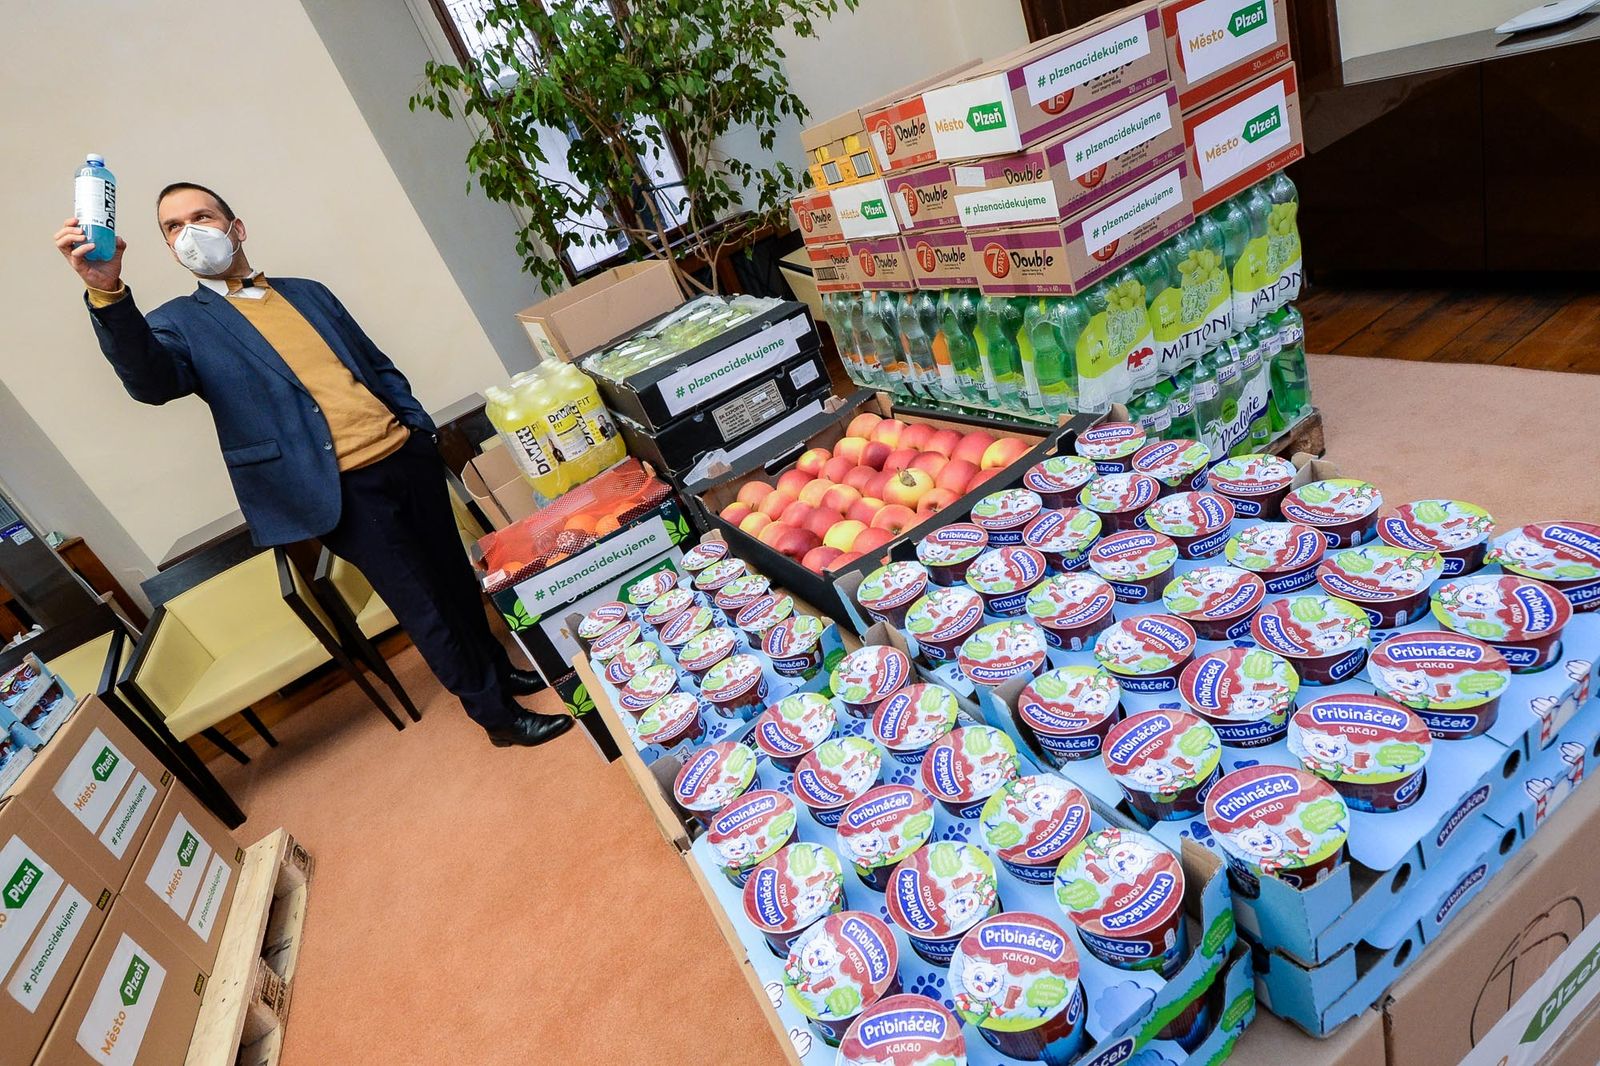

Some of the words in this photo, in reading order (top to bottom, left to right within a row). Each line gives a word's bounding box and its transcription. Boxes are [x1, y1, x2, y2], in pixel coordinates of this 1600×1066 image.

[1189, 29, 1224, 53] Město
[1235, 6, 1264, 31] Plzeň
[1048, 35, 1139, 84] plzenacidekujeme
[894, 118, 926, 141] Double
[935, 119, 964, 134] Město
[973, 108, 1002, 126] Plzeň
[1085, 112, 1161, 160] plzenacidekujeme
[1205, 138, 1239, 162] Město
[1249, 112, 1278, 138] Plzeň
[1004, 162, 1043, 184] Double
[864, 203, 886, 216] Plzeň
[916, 185, 948, 204] Double
[973, 196, 1047, 216] plzenacidekujeme
[1102, 186, 1174, 236] plzenacidekujeme
[810, 208, 832, 224] Double
[874, 254, 898, 268] Double
[935, 246, 966, 264] Double
[986, 246, 1001, 274] 7
[1010, 250, 1054, 268] Double
[1161, 311, 1232, 364] MATTONI
[675, 386, 686, 399] #
[688, 338, 786, 394] plzenacidekujeme
[577, 396, 591, 408] FIT
[552, 422, 564, 430] FIT
[941, 531, 980, 541] Pribináček
[1100, 537, 1152, 554] Pribináček
[534, 589, 546, 601] #
[548, 533, 656, 596] plzenacidekujeme
[1210, 585, 1256, 617] Pribináček
[1328, 576, 1394, 600] Pribináček
[1521, 588, 1550, 631] Pribináček
[1143, 622, 1188, 649] Pribináček
[1265, 618, 1304, 655] Pribináček
[1391, 646, 1476, 660] Pribináček
[1200, 660, 1224, 706] Pribináček
[883, 698, 906, 738] Pribináček
[1030, 705, 1086, 728] Pribináček
[1316, 707, 1402, 728] Pribináček
[766, 724, 800, 752] Pribináček
[1114, 717, 1167, 762] Pribináček
[74, 782, 97, 812] Město
[96, 750, 118, 778] Plzeň
[682, 753, 716, 795] Pribináček
[803, 772, 843, 803] Pribináček
[938, 750, 957, 795] Pribináček
[117, 784, 148, 840] plzenacidekujeme
[720, 799, 772, 831] Pribináček
[853, 794, 909, 824] Pribináček
[1218, 778, 1294, 816] Pribináček
[1033, 809, 1081, 857] Pribináček
[1438, 790, 1488, 842] Pribináček
[8, 864, 38, 903] Plzeň
[165, 868, 184, 899] Město
[180, 836, 197, 863] Plzeň
[760, 872, 781, 924] Pribináček
[902, 872, 932, 930] Pribináček
[1108, 878, 1170, 927] Pribináček
[1436, 870, 1485, 922] Pribináček
[30, 900, 80, 984] plzenacidekujeme
[847, 922, 889, 978] Pribináček
[985, 928, 1060, 954] Pribináček
[100, 1010, 127, 1056] Město
[124, 961, 146, 1000] Plzeň
[864, 1016, 942, 1040] Pribináček
